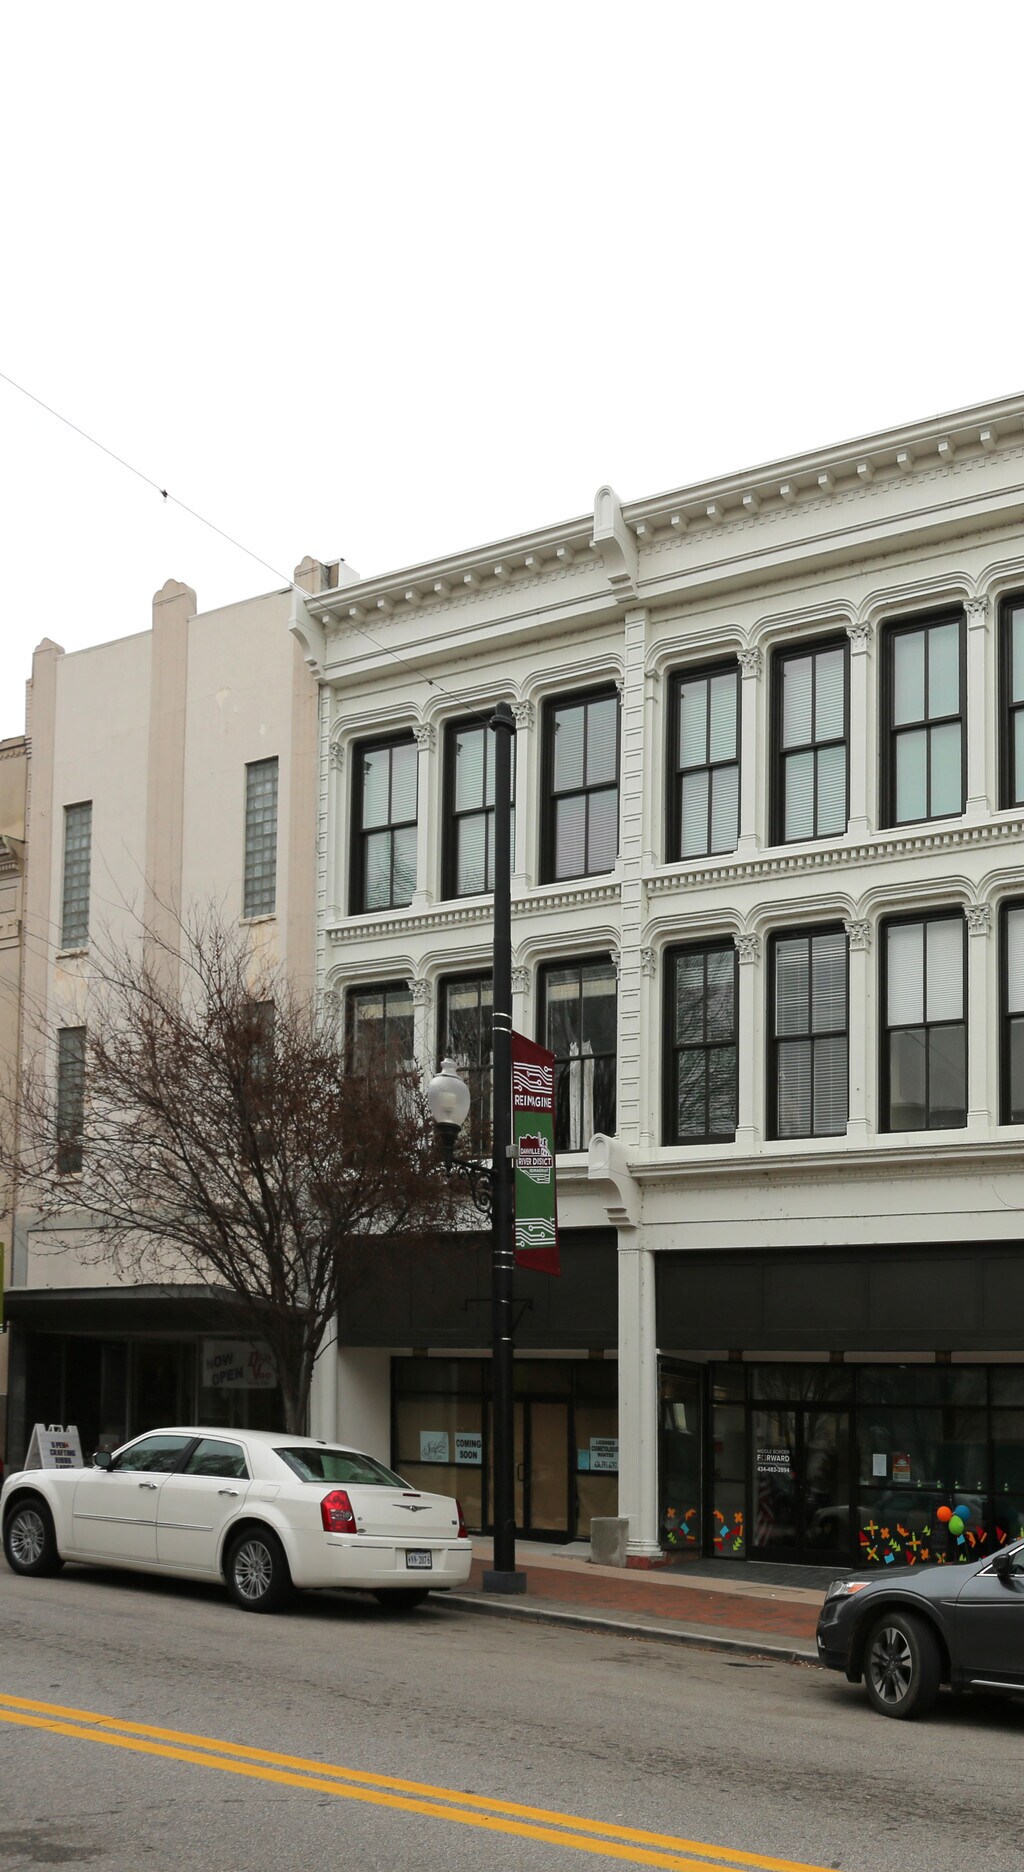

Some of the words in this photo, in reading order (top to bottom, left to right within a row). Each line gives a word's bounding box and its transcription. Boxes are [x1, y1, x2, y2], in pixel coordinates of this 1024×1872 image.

[514, 1094, 552, 1108] REIMAGINE
[206, 1352, 233, 1370] NOW
[212, 1366, 243, 1386] OPEN
[456, 1439, 481, 1448] COMING
[460, 1450, 477, 1459] SOON
